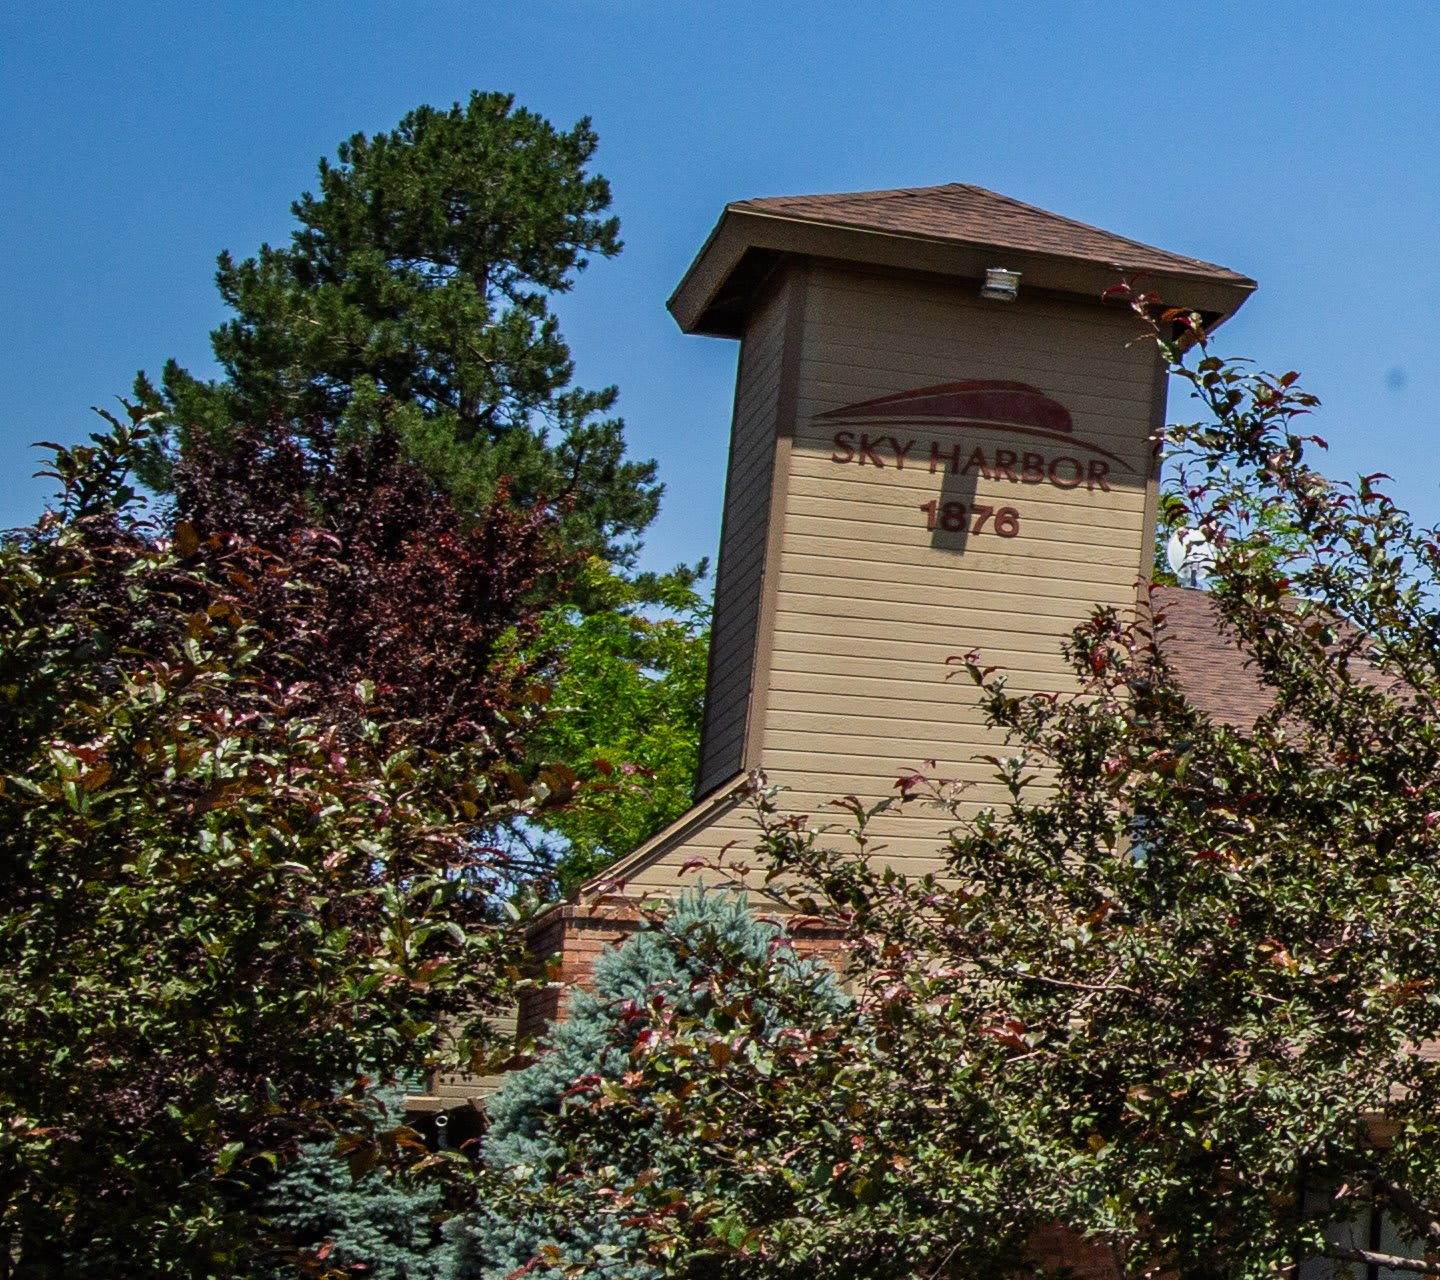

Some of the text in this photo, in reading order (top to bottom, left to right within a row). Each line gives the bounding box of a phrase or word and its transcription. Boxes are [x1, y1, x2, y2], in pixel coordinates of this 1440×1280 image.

[832, 431, 1111, 493] SKY HARBOR
[920, 499, 1020, 538] 1876
